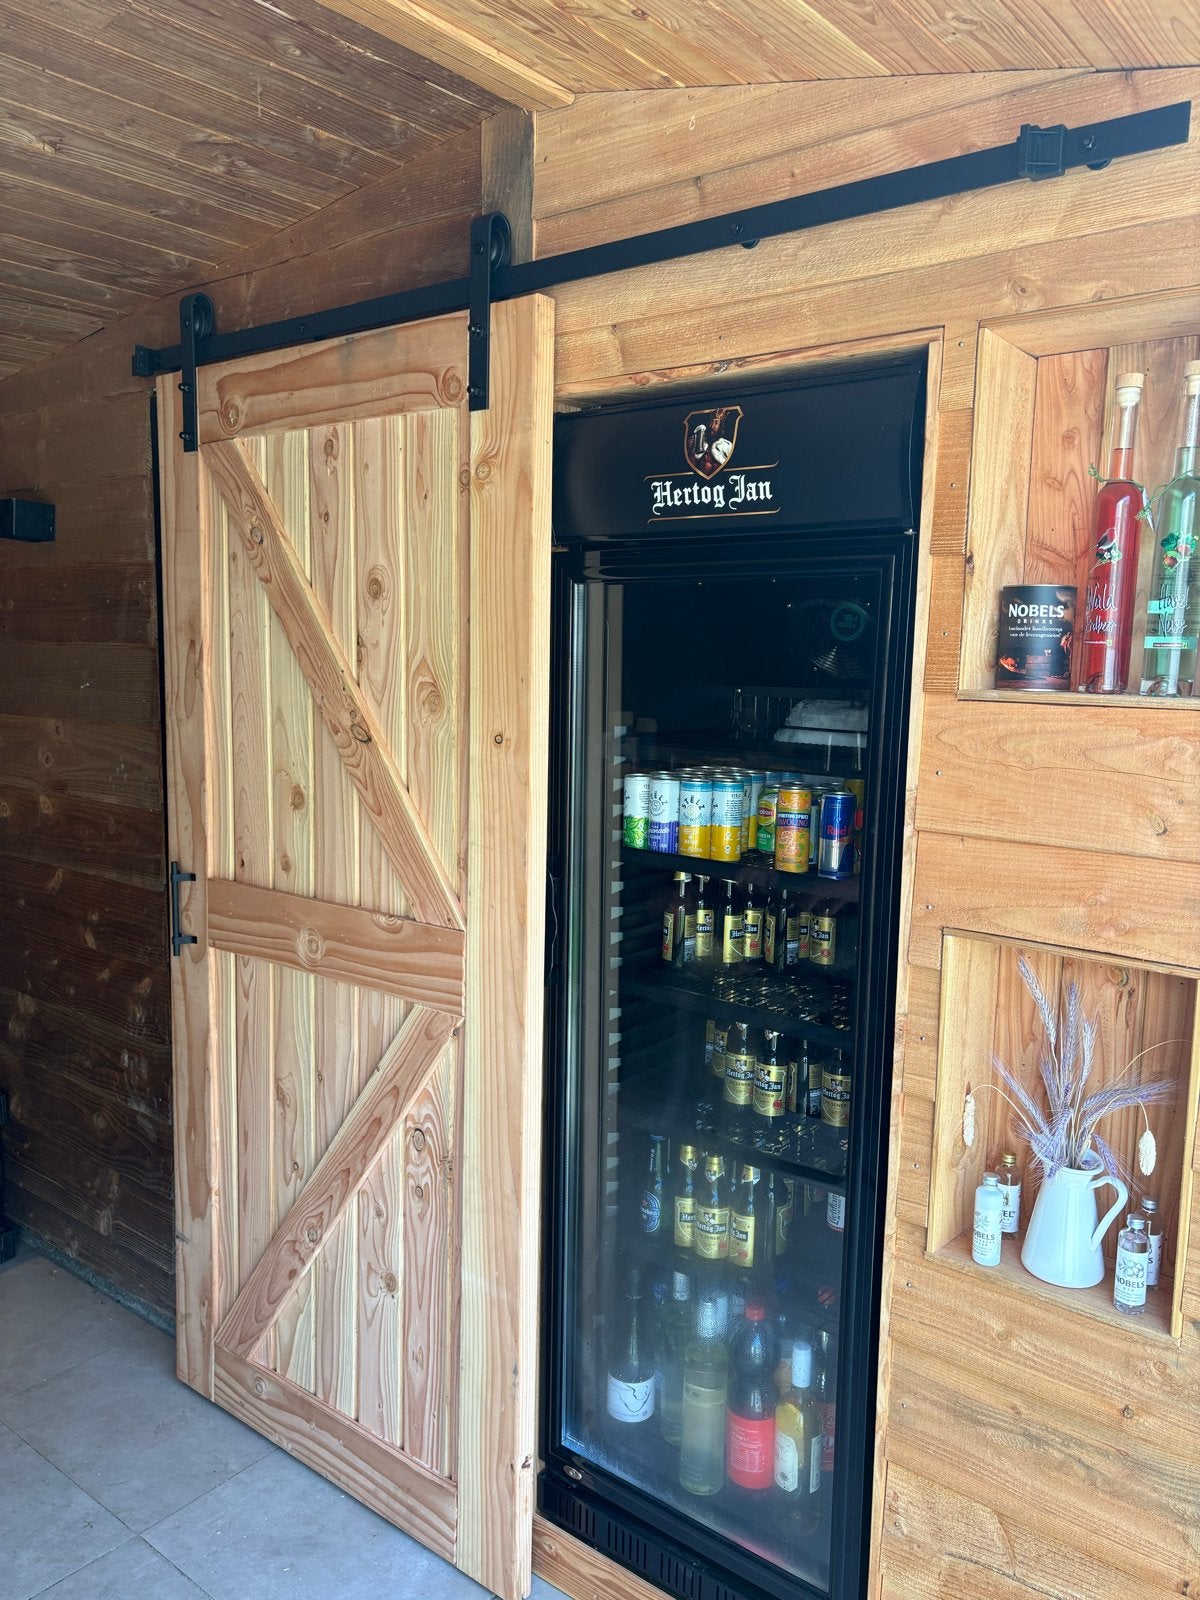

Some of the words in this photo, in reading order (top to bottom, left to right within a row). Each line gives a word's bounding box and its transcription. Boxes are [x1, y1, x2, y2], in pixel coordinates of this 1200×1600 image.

[650, 480, 726, 515] Hertog
[728, 474, 773, 510] Jan
[1008, 603, 1065, 618] NOBELS
